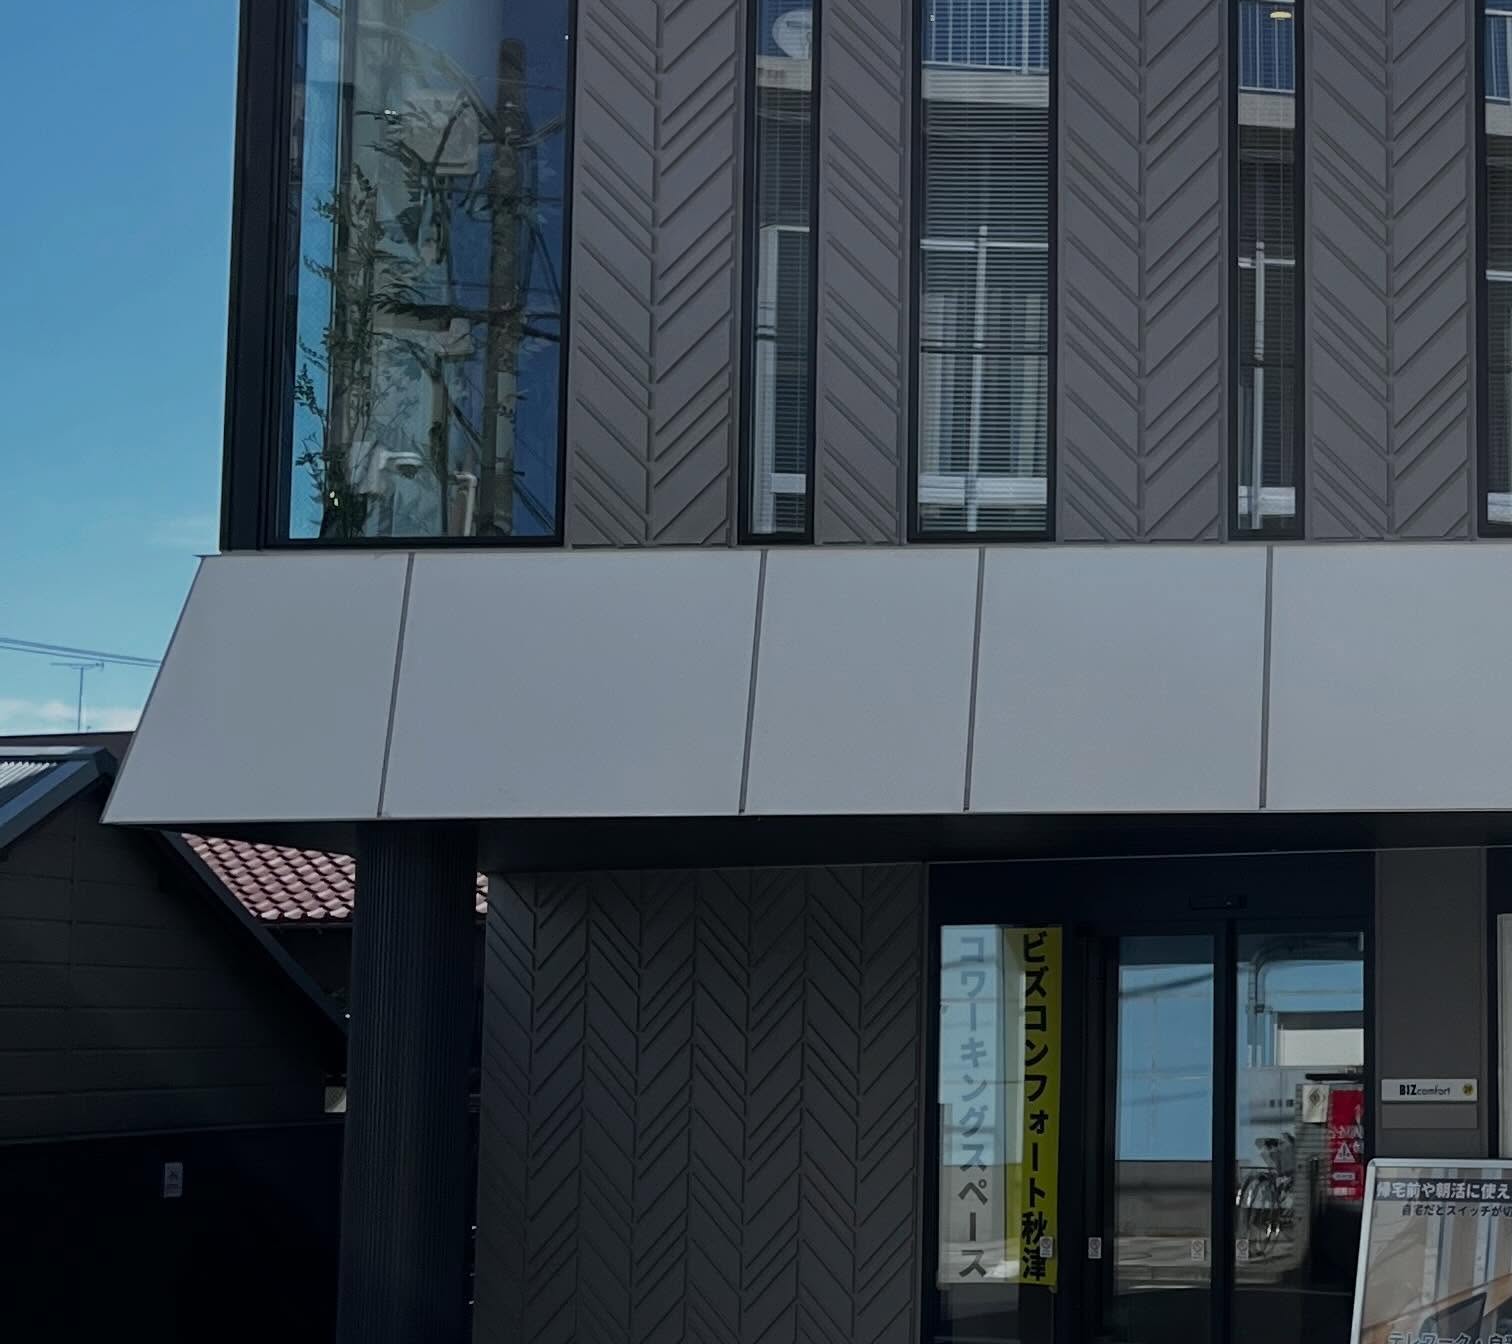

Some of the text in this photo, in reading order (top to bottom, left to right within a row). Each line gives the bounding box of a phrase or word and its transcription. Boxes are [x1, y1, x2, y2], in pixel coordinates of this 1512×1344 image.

[957, 936, 988, 1278] コワーキングスペース
[1021, 930, 1050, 1281] ビズコンフォート秋津
